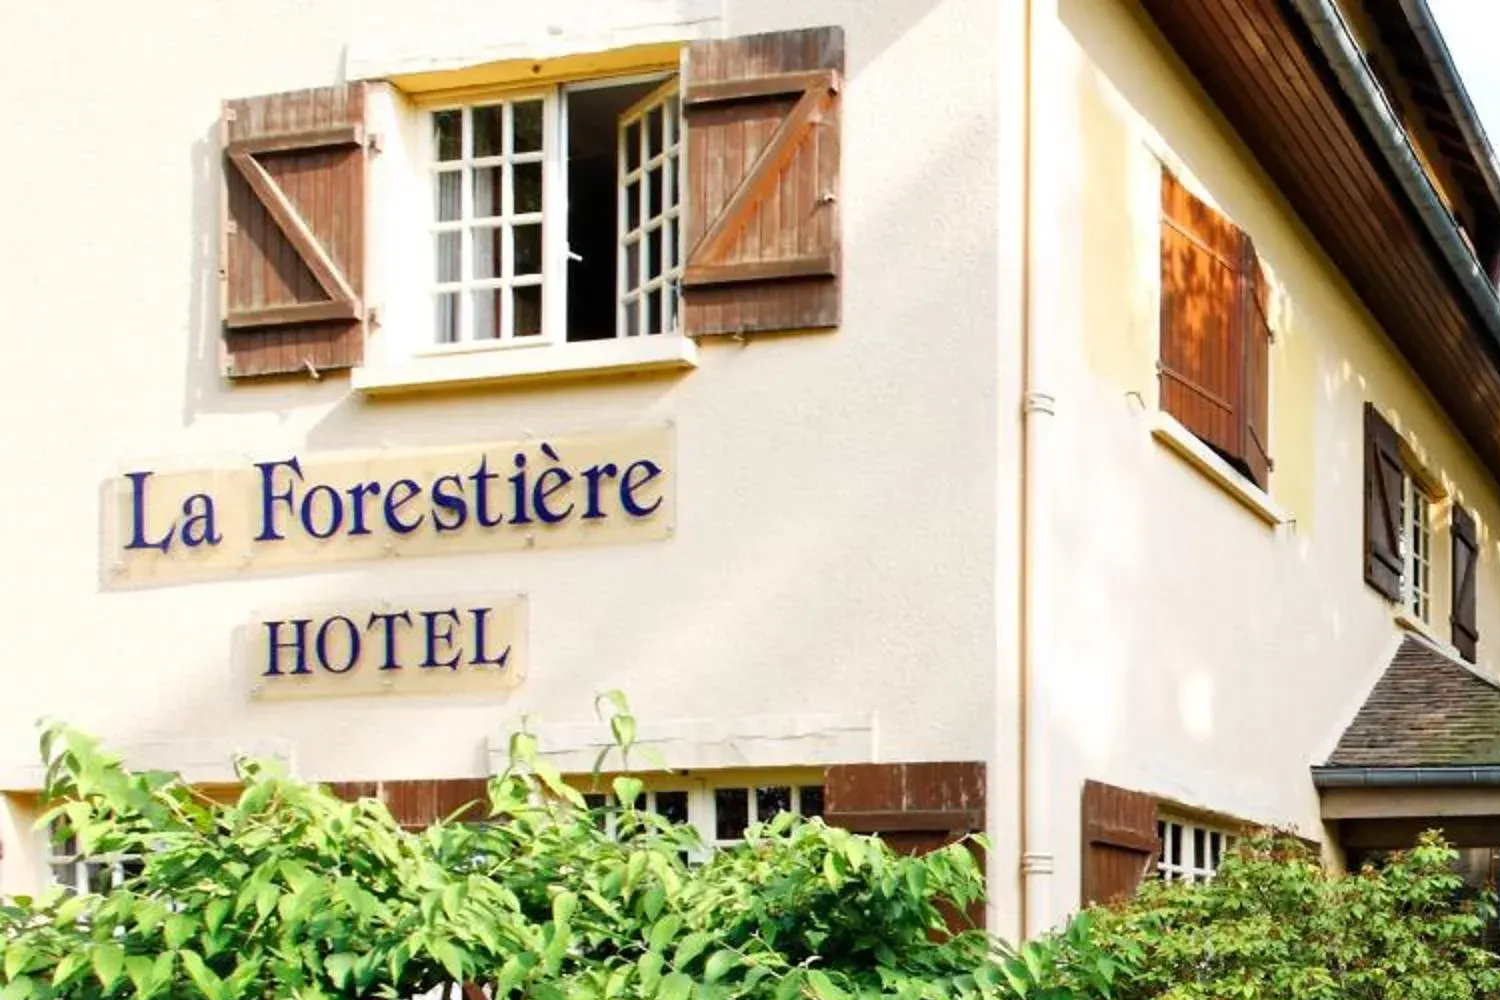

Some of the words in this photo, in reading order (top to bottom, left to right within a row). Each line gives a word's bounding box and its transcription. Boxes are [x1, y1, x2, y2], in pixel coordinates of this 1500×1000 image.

[123, 471, 223, 554] La
[253, 442, 664, 541] Forestière
[261, 606, 513, 677] HOTEL
